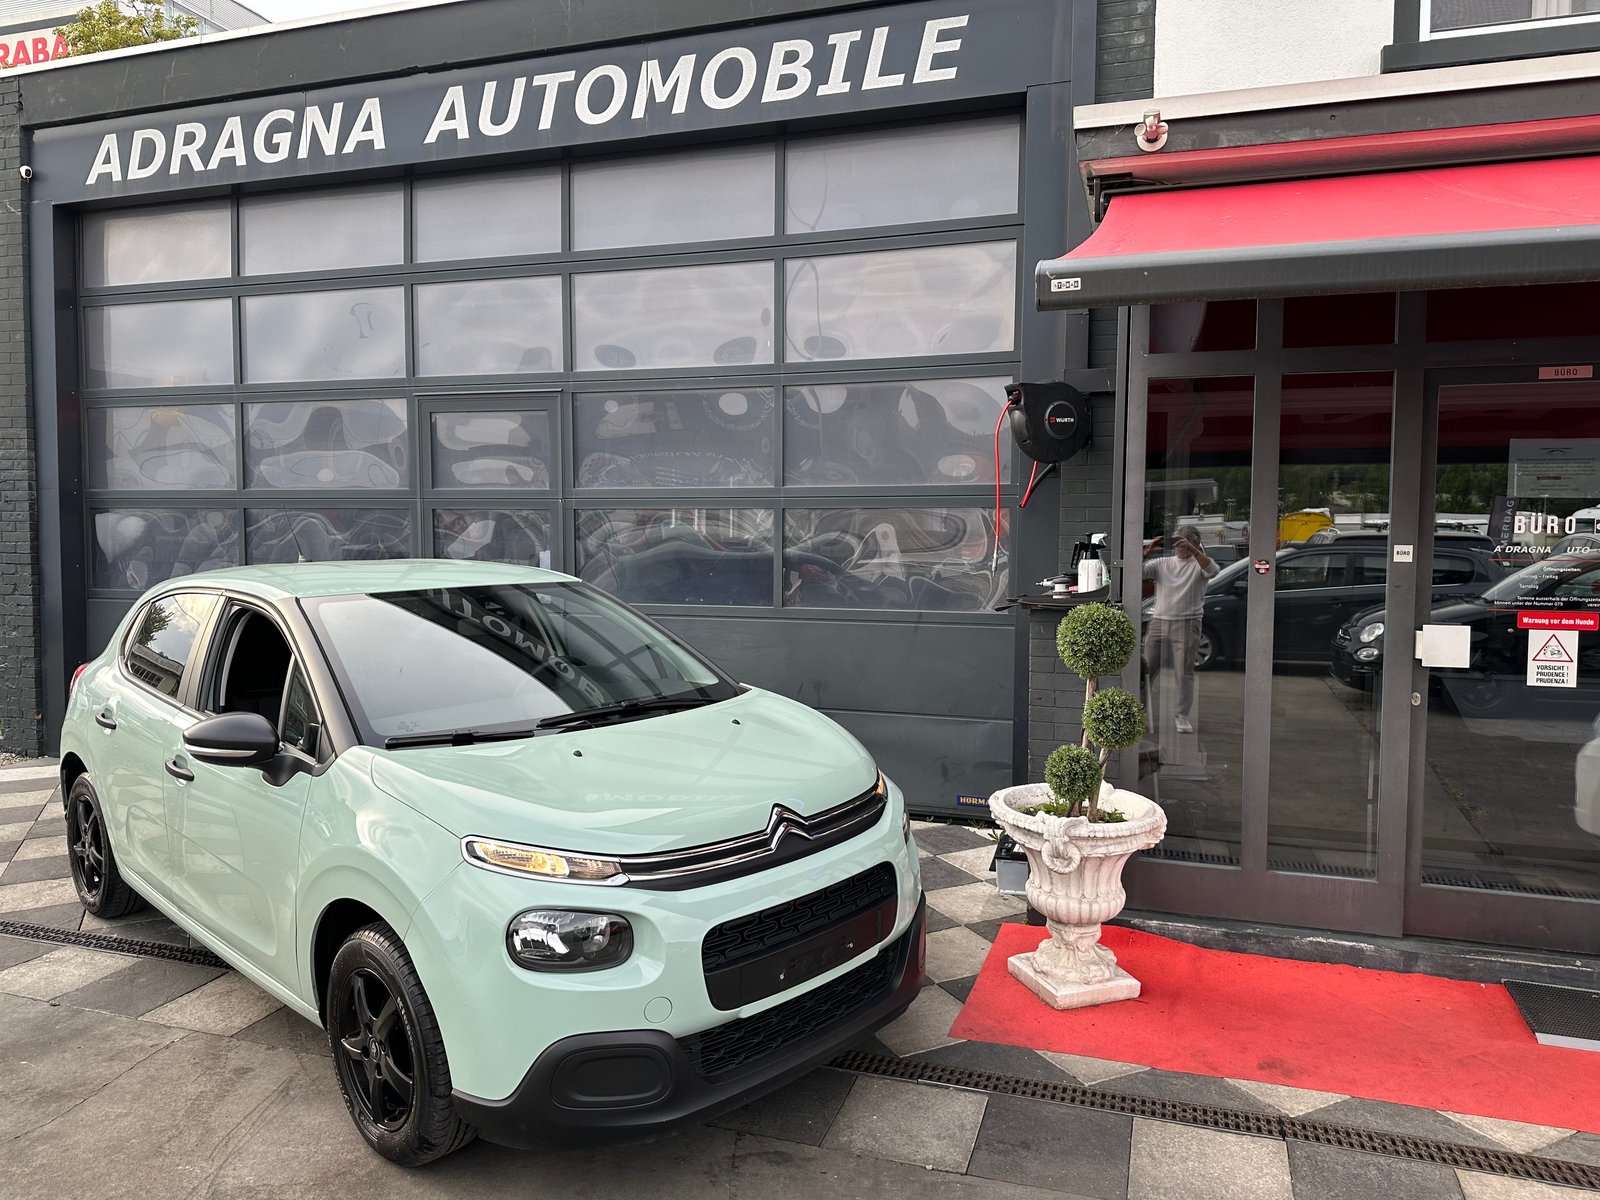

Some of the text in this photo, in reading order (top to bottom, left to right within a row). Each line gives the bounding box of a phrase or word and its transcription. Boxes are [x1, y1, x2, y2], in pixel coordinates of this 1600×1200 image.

[86, 14, 970, 185] ADRAGNA AUTOMOBILE
[1554, 367, 1578, 376] BÜRO
[1514, 512, 1577, 534] BÜRO
[1523, 616, 1549, 625] Warnung
[1575, 618, 1595, 626] Hunde
